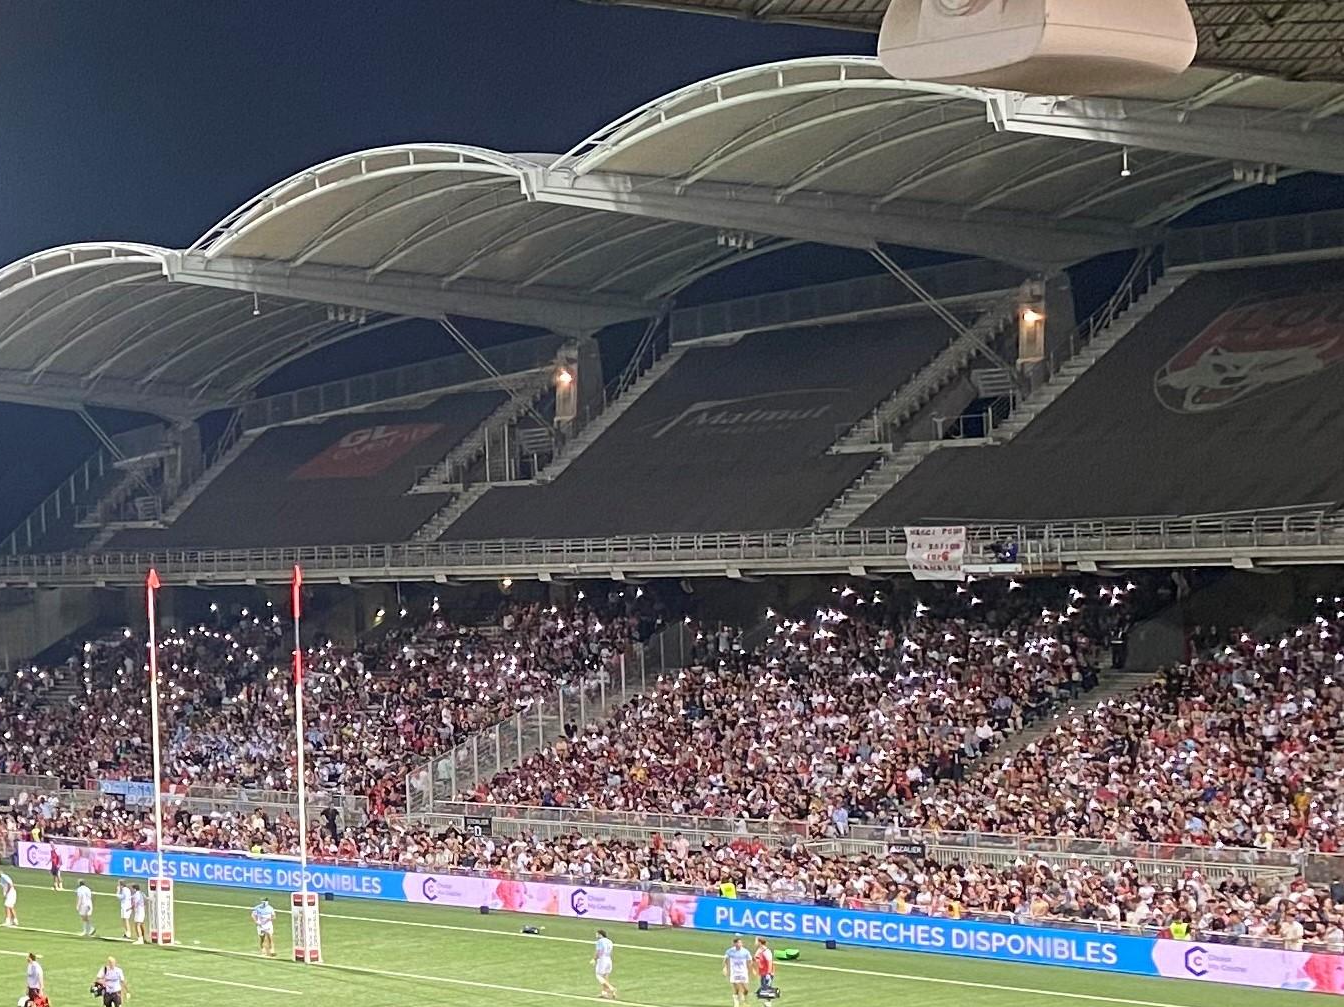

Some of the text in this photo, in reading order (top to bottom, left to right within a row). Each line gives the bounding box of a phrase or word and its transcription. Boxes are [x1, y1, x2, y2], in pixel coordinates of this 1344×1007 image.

[181, 862, 200, 878] EN
[204, 865, 273, 885] CRECHES
[276, 869, 382, 894] DISPONIBLES
[716, 907, 1118, 965] PLACES EN CRECHES DISPONIBLES
